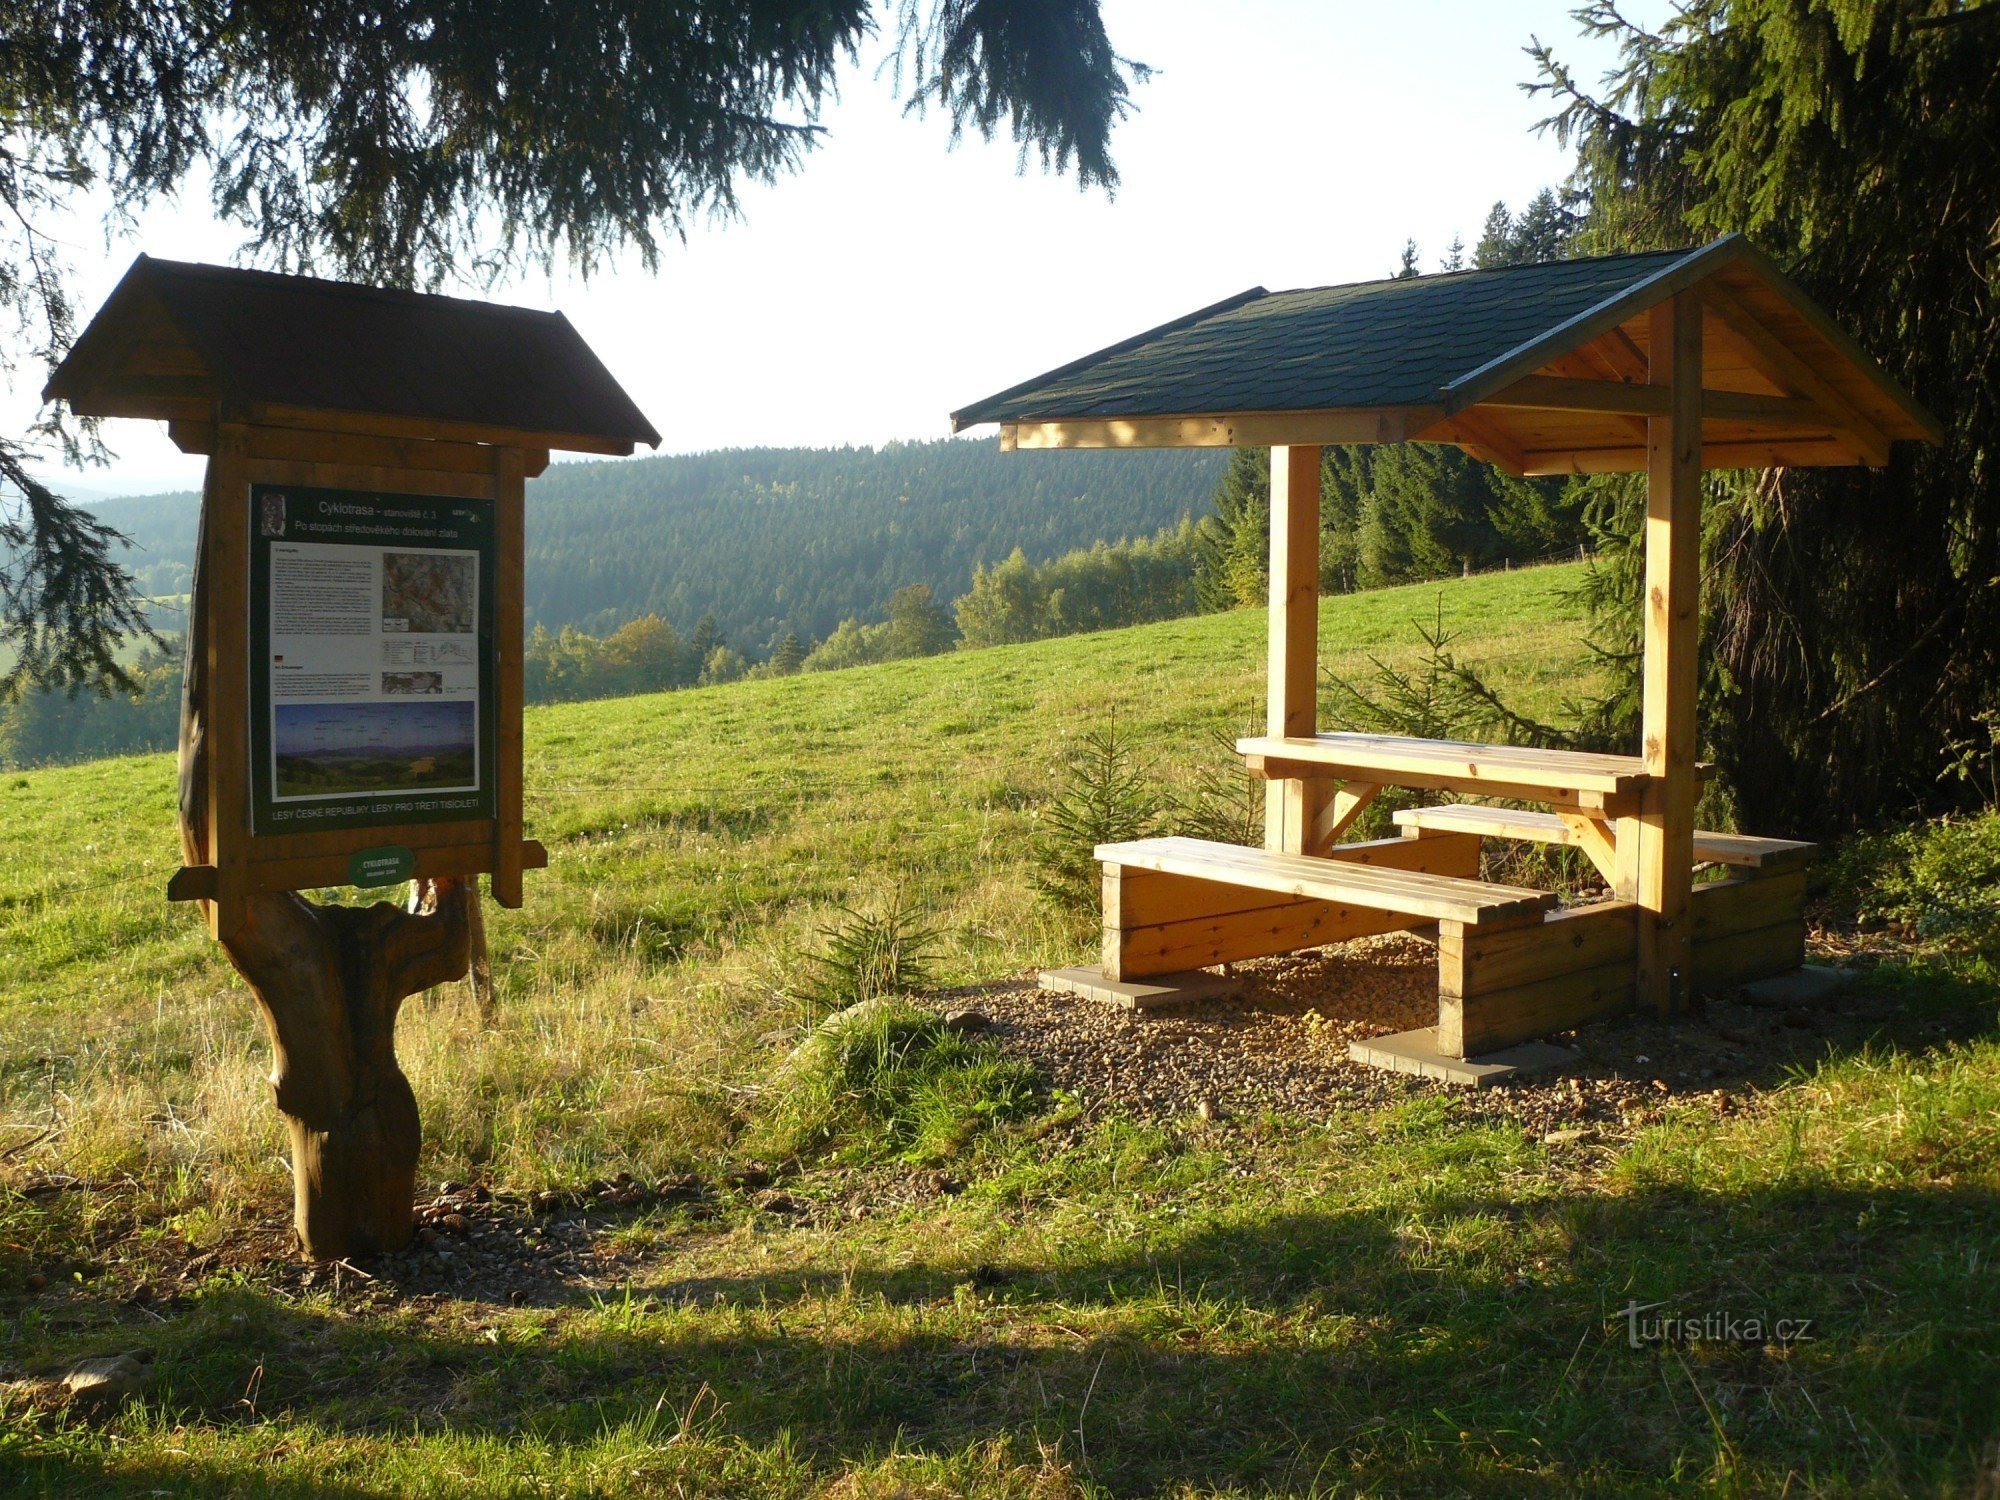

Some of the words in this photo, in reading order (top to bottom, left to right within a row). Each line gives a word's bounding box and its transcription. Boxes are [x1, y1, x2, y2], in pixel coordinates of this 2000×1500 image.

[318, 501, 374, 516] Cyklotrasa
[295, 520, 307, 531] Po
[309, 522, 342, 534] stopách
[272, 811, 294, 821] LESY
[295, 807, 323, 819] ČESKÉ
[371, 803, 394, 814] LESY
[395, 802, 413, 812] PRO
[415, 799, 438, 811] TŘETÍ
[440, 798, 479, 810] TISÍCILETÍ
[363, 857, 400, 869] CYKLOTRASA
